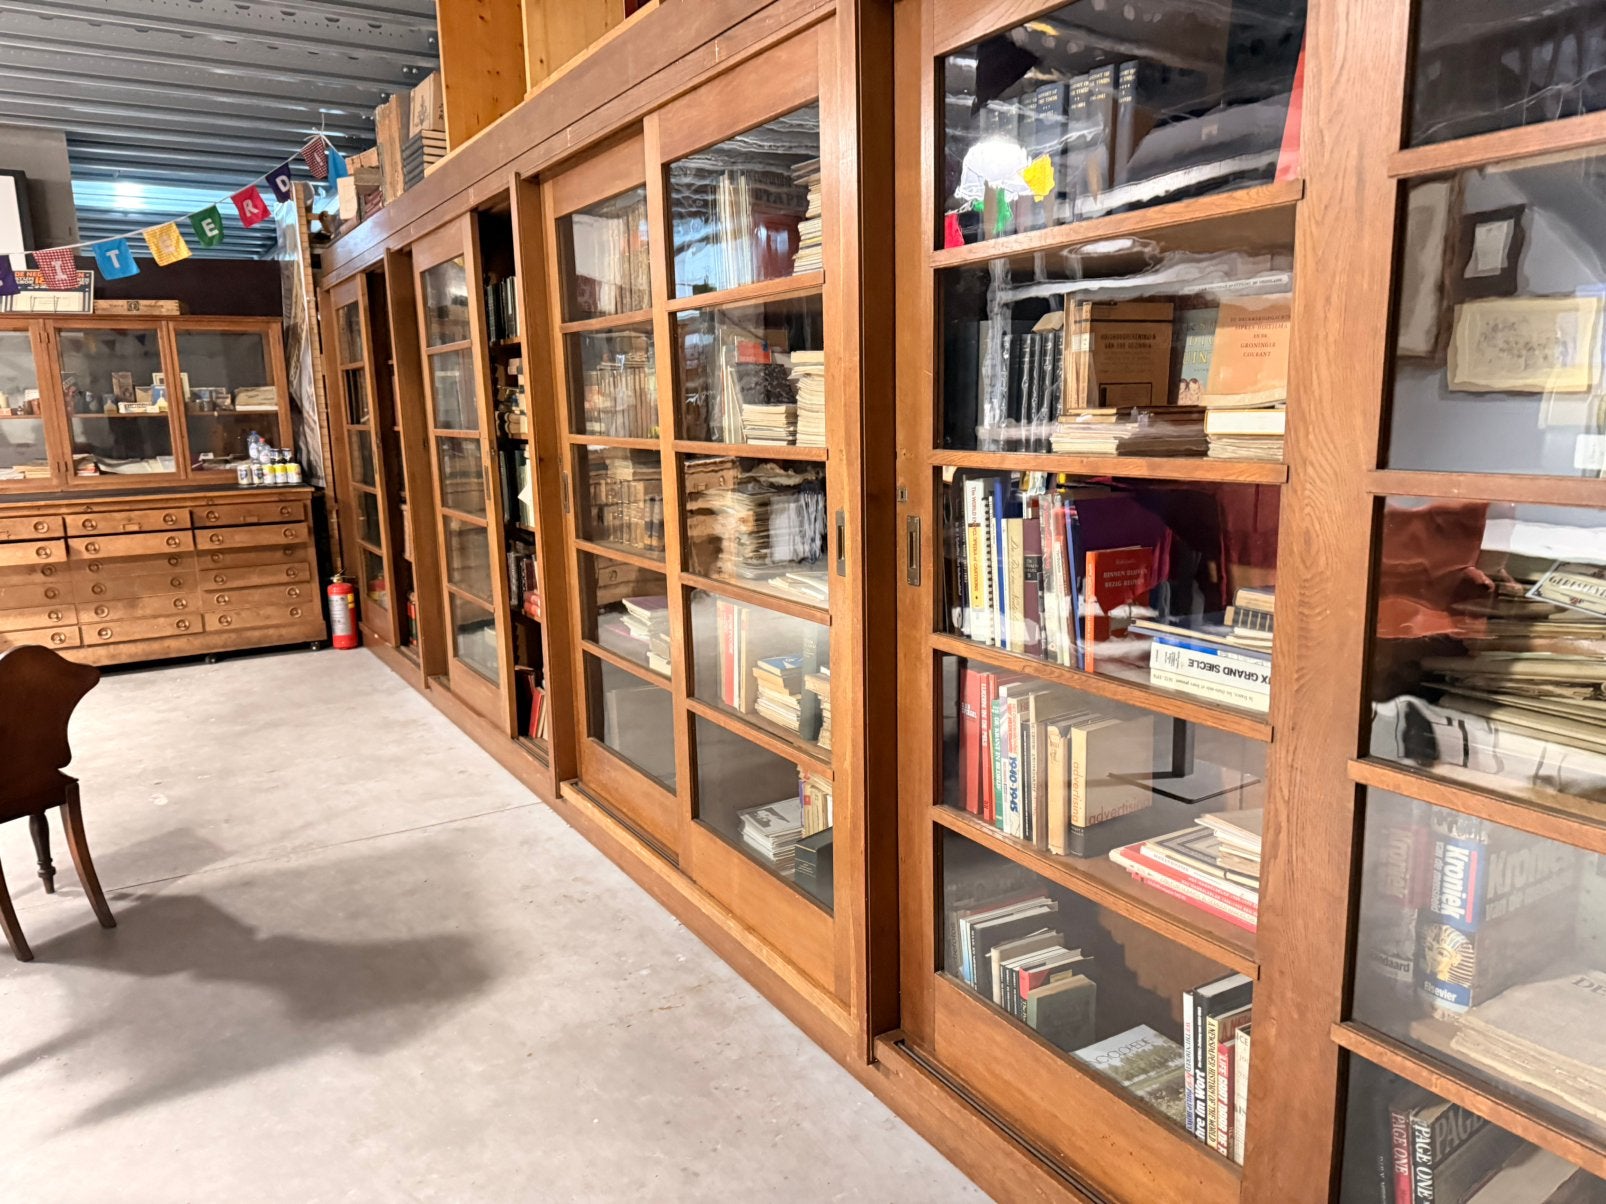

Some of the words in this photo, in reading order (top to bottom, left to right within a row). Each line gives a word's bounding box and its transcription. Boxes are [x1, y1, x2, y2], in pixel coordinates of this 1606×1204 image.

[1187, 658, 1221, 674] SIECLE
[1222, 666, 1259, 682] GRAND
[1072, 761, 1084, 823] advertising
[1441, 844, 1470, 919] Kroniek
[1424, 981, 1457, 1002] Elsevier
[1195, 1068, 1205, 1101] Wort
[1392, 1113, 1407, 1147] PAGE
[1414, 1124, 1432, 1165] PAGE
[1394, 1147, 1409, 1176] ONE
[1416, 1166, 1433, 1200] ONE
